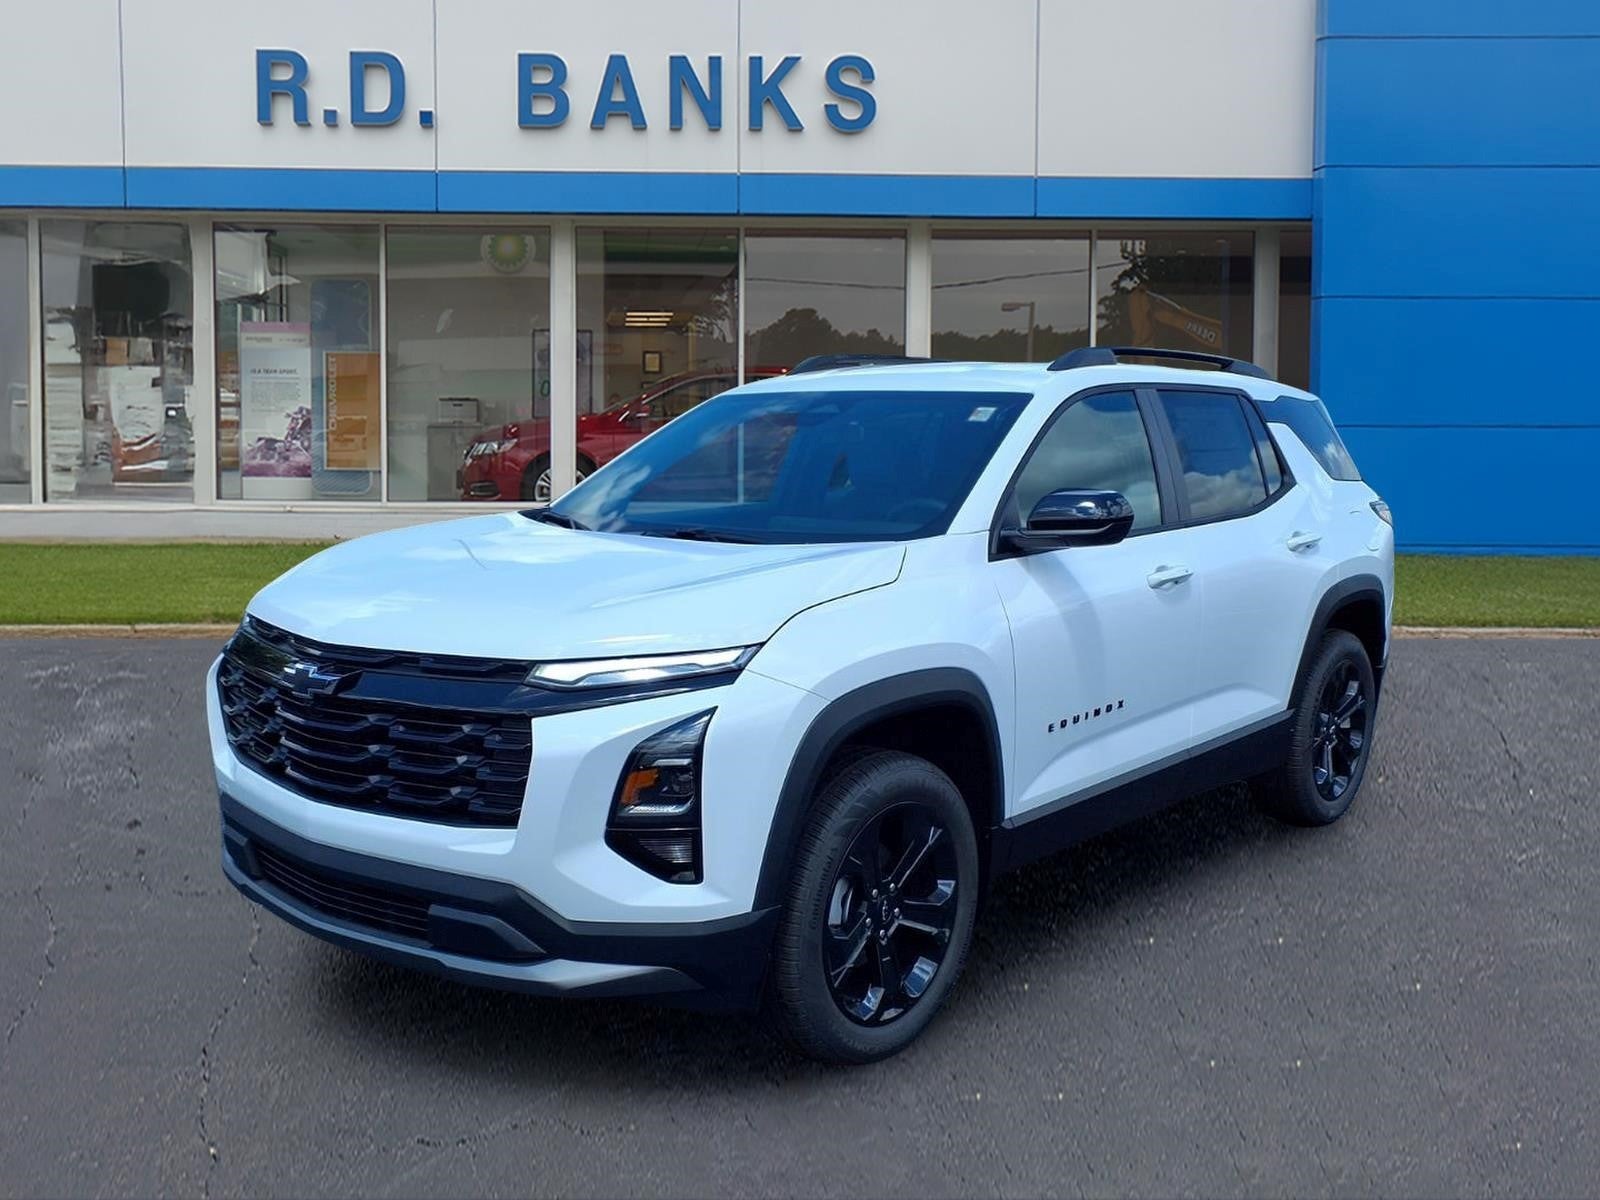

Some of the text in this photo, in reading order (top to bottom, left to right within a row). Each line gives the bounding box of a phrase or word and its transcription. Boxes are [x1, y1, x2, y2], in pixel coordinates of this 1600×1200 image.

[256, 49, 877, 134] R.D. BANKS
[1048, 700, 1124, 733] EQUINOX
